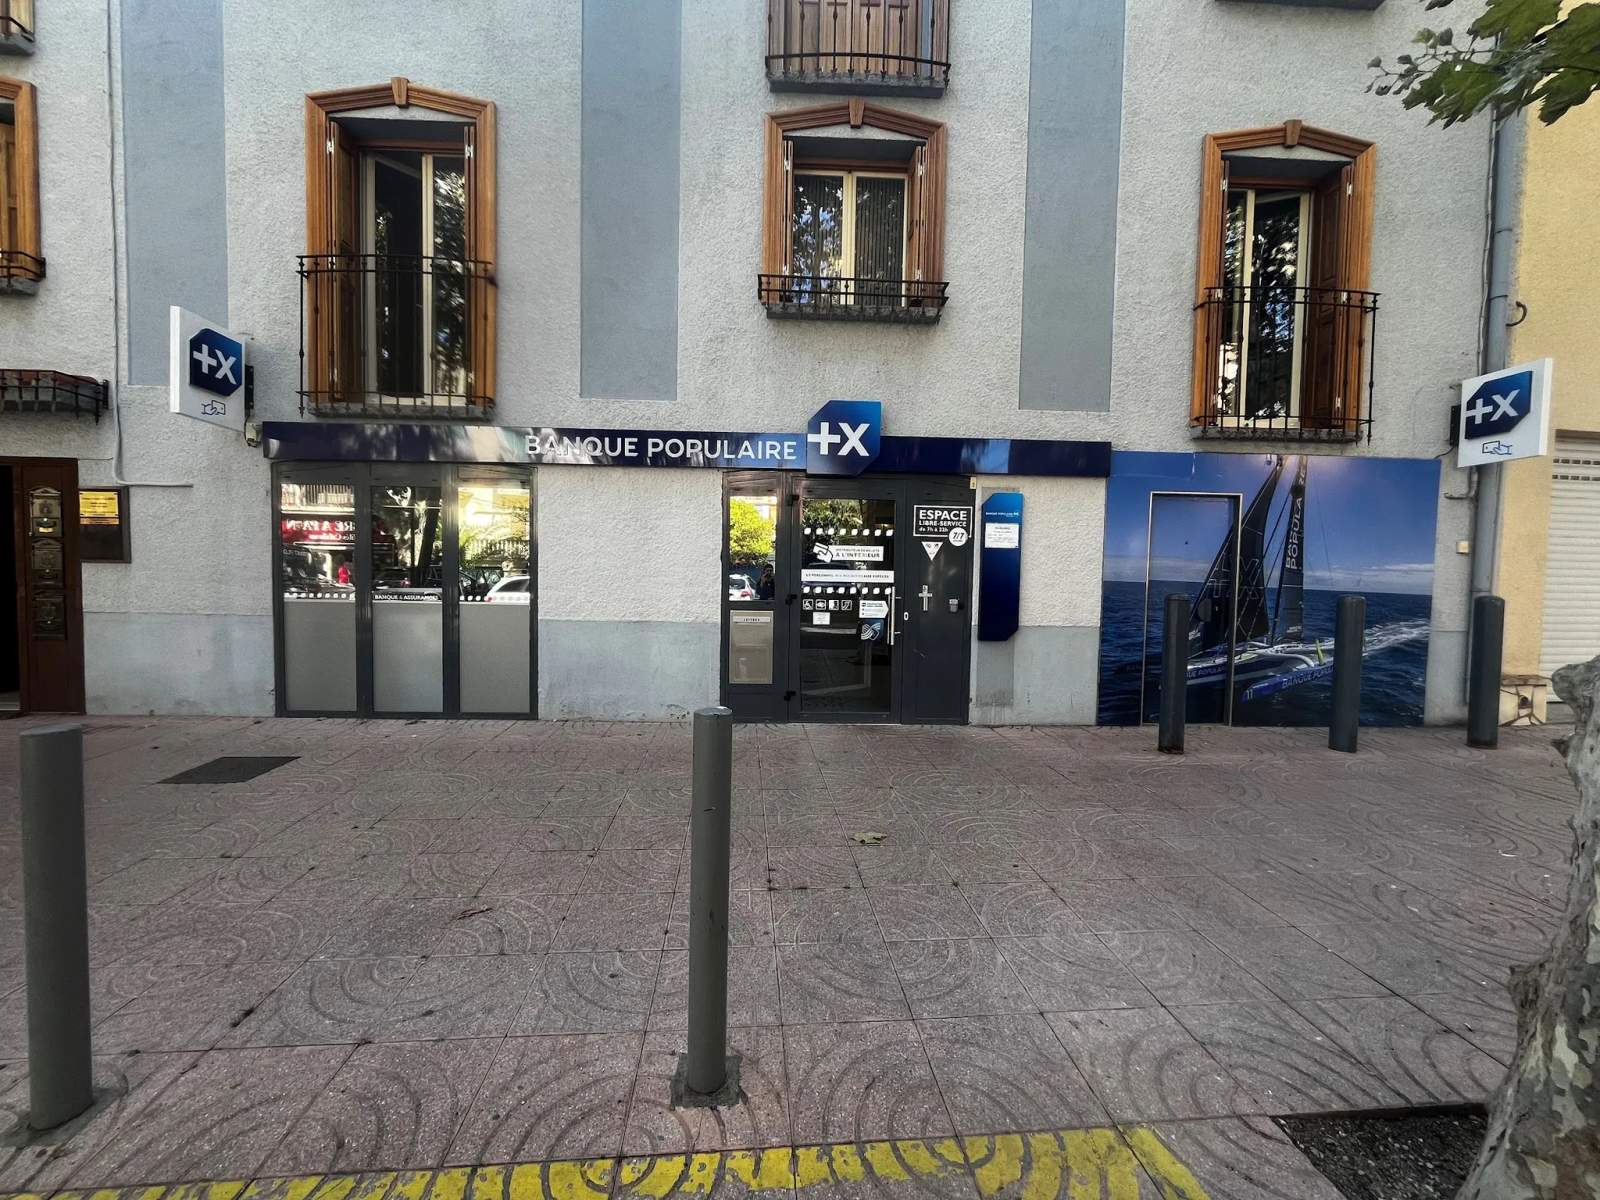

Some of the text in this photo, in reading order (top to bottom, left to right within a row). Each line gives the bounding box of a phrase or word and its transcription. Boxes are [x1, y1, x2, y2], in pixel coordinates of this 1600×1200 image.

[525, 435, 797, 460] BANQUE POPULAIRE
[919, 509, 967, 521] ESPACE
[952, 532, 965, 540] 7/7
[1281, 671, 1313, 689] BANQUE
